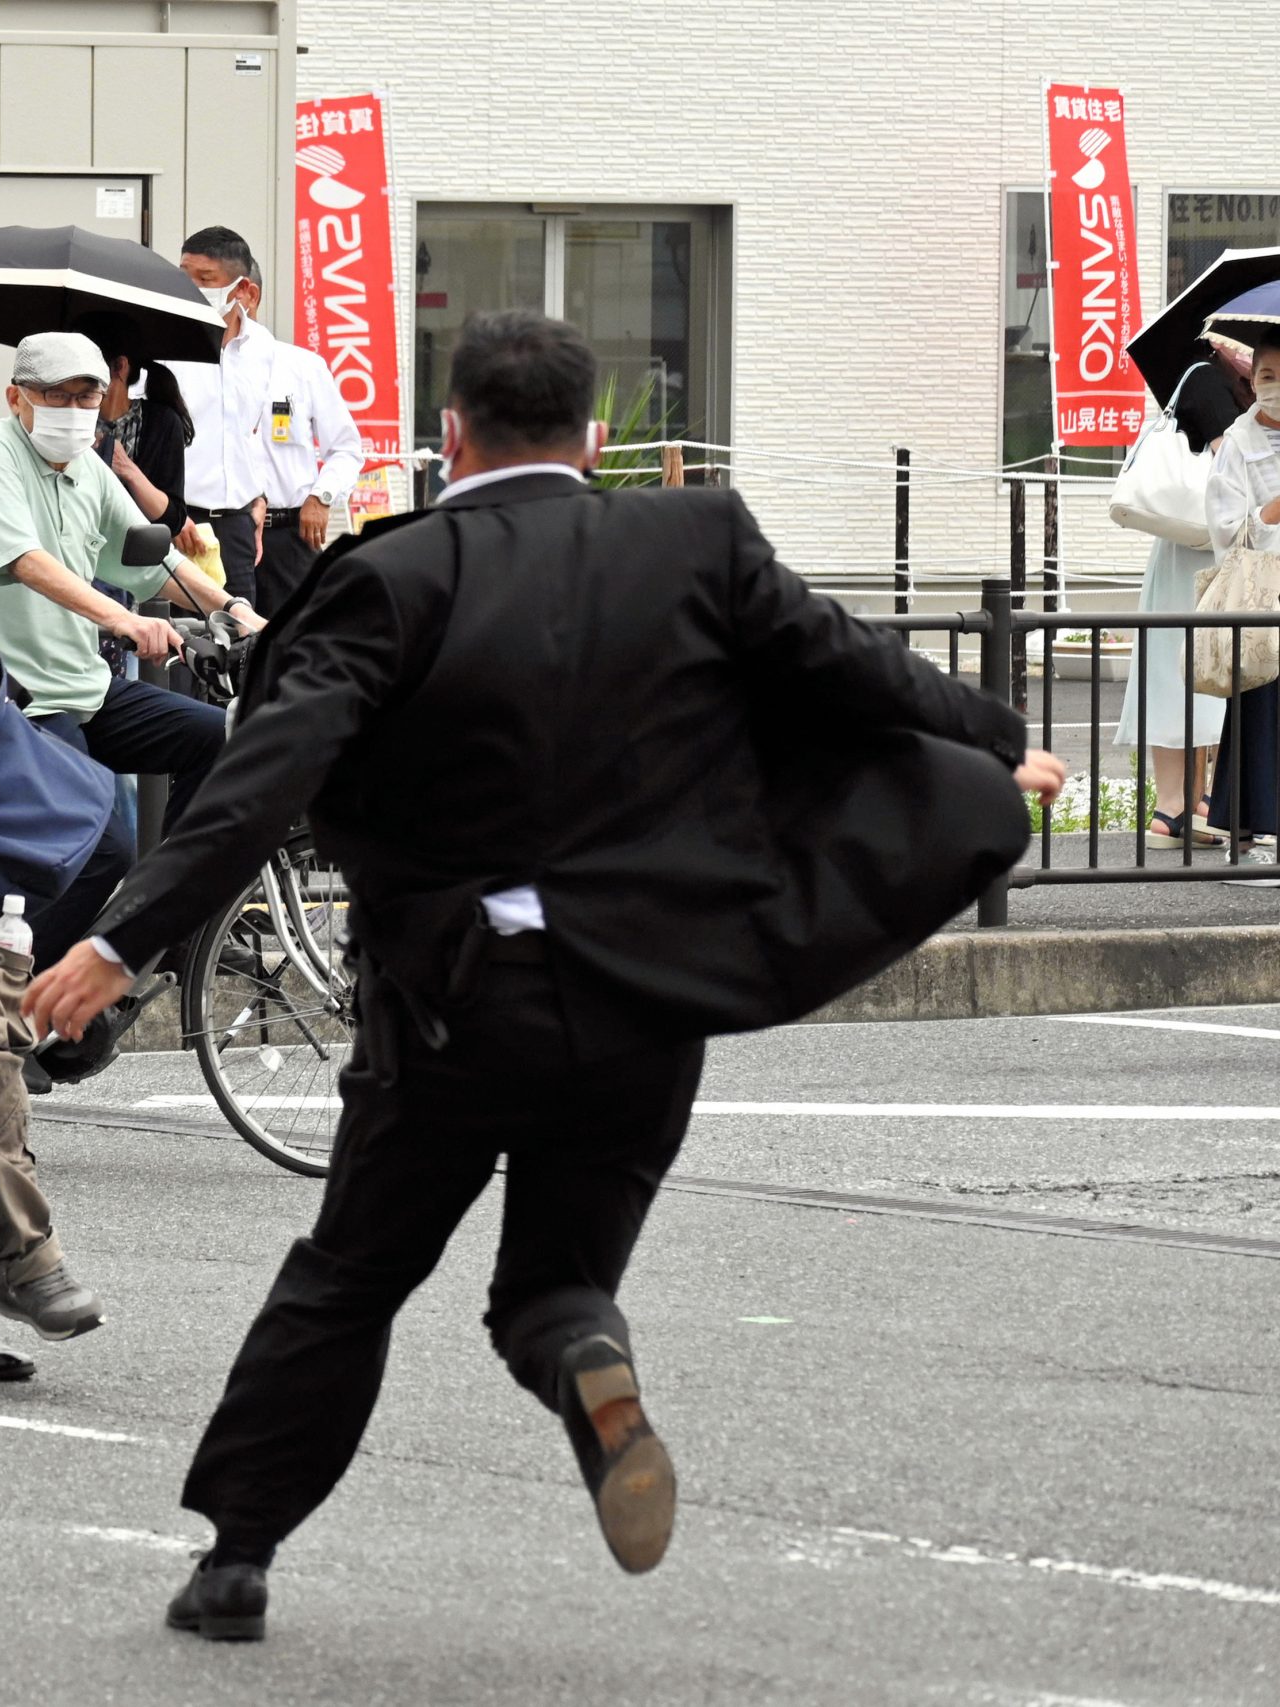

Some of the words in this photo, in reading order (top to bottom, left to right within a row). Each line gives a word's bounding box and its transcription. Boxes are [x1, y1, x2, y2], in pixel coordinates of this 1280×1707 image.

[1054, 96, 1122, 122] 賃貸住宅
[1078, 193, 1116, 382] SANKO
[1061, 407, 1141, 434] 山晃住宅
